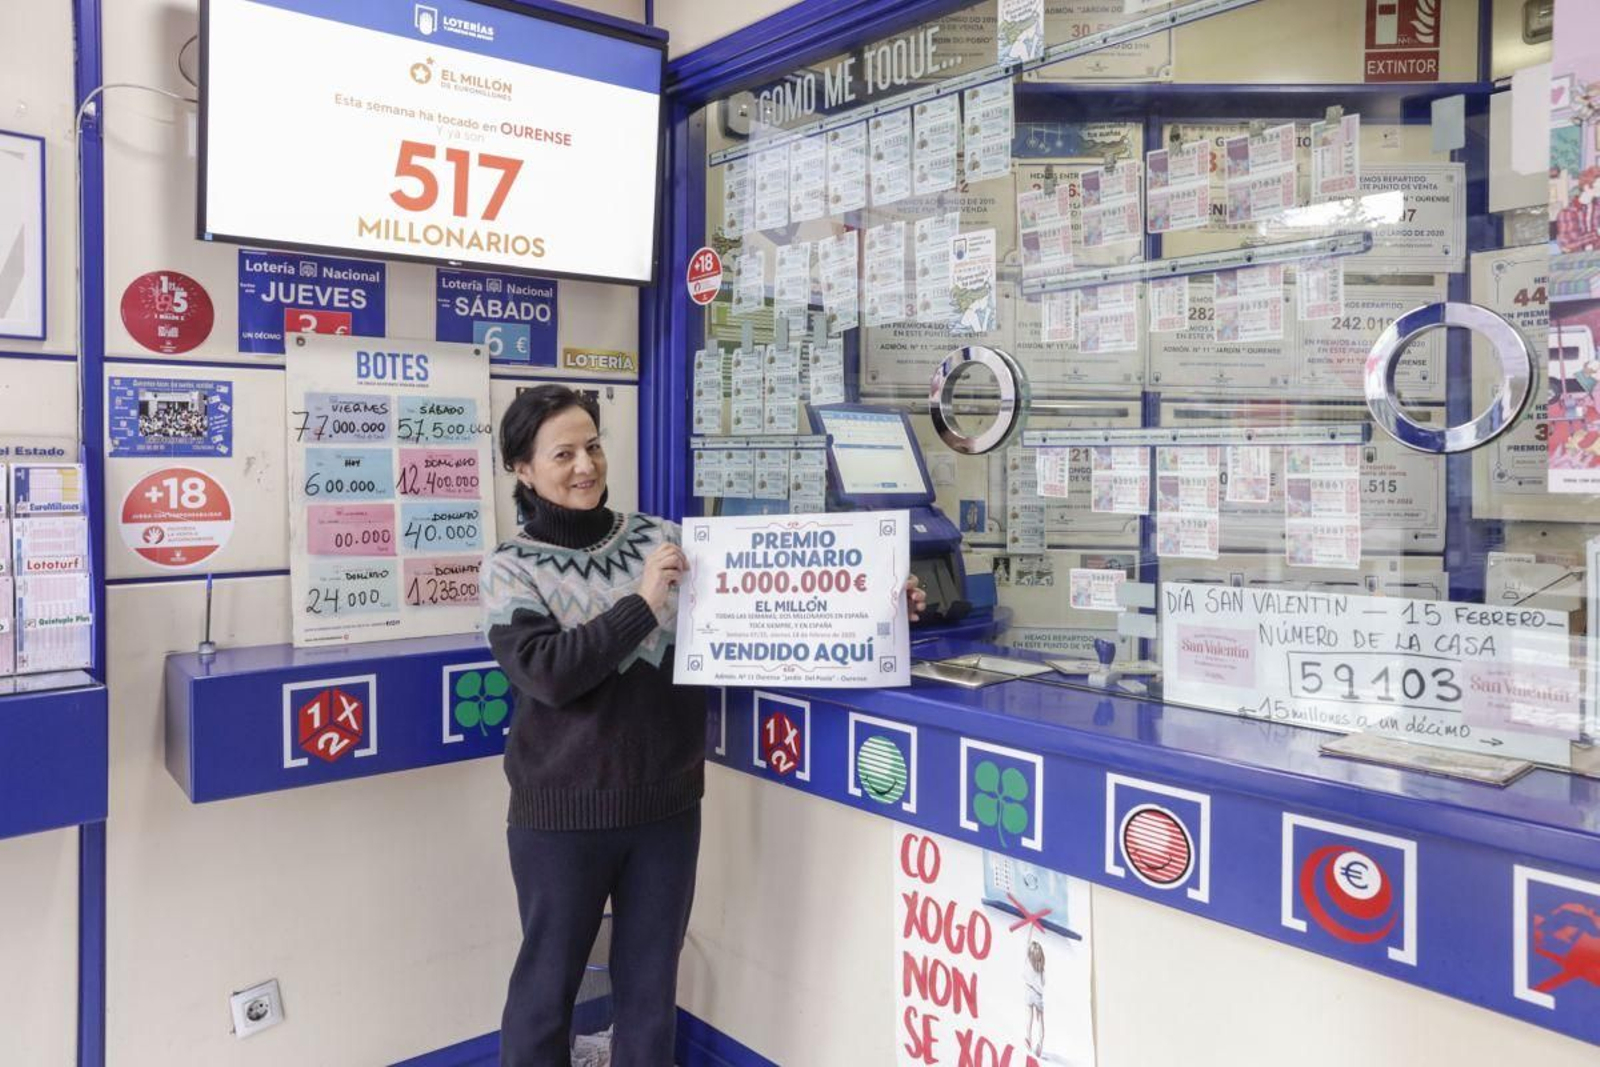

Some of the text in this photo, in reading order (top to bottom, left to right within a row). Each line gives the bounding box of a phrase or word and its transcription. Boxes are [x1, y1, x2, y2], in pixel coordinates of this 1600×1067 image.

[441, 69, 458, 83] EL
[1367, 58, 1437, 75] EXTINTOR
[824, 57, 856, 109] ME
[334, 93, 572, 146] Esta semana ha tocado en OURENSE
[389, 139, 524, 222] 517
[1383, 175, 1427, 183] REPARTIDO
[1413, 183, 1438, 191] VENTA
[357, 216, 546, 258] MILLONARIOS
[245, 259, 380, 283] Lotería Nacional
[694, 253, 714, 273] +18
[261, 281, 367, 309] JUEVES
[442, 278, 553, 298] Lotería Nacional
[455, 294, 551, 323] SÁBADO
[484, 326, 528, 356] 6 €
[356, 351, 429, 382] BOTES
[565, 353, 635, 371] LOTERÍA
[331, 403, 389, 415] VIERNES
[15, 446, 65, 456] Estado
[145, 477, 207, 509] +18
[29, 503, 79, 512] EuroMillones
[751, 530, 836, 549] PREMIO
[27, 558, 79, 570] Lototurf
[725, 549, 863, 569] MILLONARIO
[755, 601, 772, 612] EL
[793, 611, 834, 619] MILLONARIOS
[1165, 587, 1195, 615] DÍA
[1204, 588, 1244, 613] SAN
[1401, 601, 1442, 626] 15
[1455, 606, 1546, 627] FEBRERO
[1024, 633, 1051, 641] HEMOS
[1258, 621, 1338, 647] NÚMERO
[1353, 629, 1386, 648] DE
[1395, 632, 1421, 651] LA
[1434, 634, 1496, 656] CASA
[710, 637, 874, 665] VENDIDO AQUÍ
[1301, 660, 1463, 702] 59103
[1379, 715, 1399, 730] un
[1406, 712, 1471, 739] décimo
[901, 833, 942, 884] CO
[902, 891, 993, 960] XOGO
[902, 951, 979, 1019] NON
[904, 1005, 942, 1066] SE
